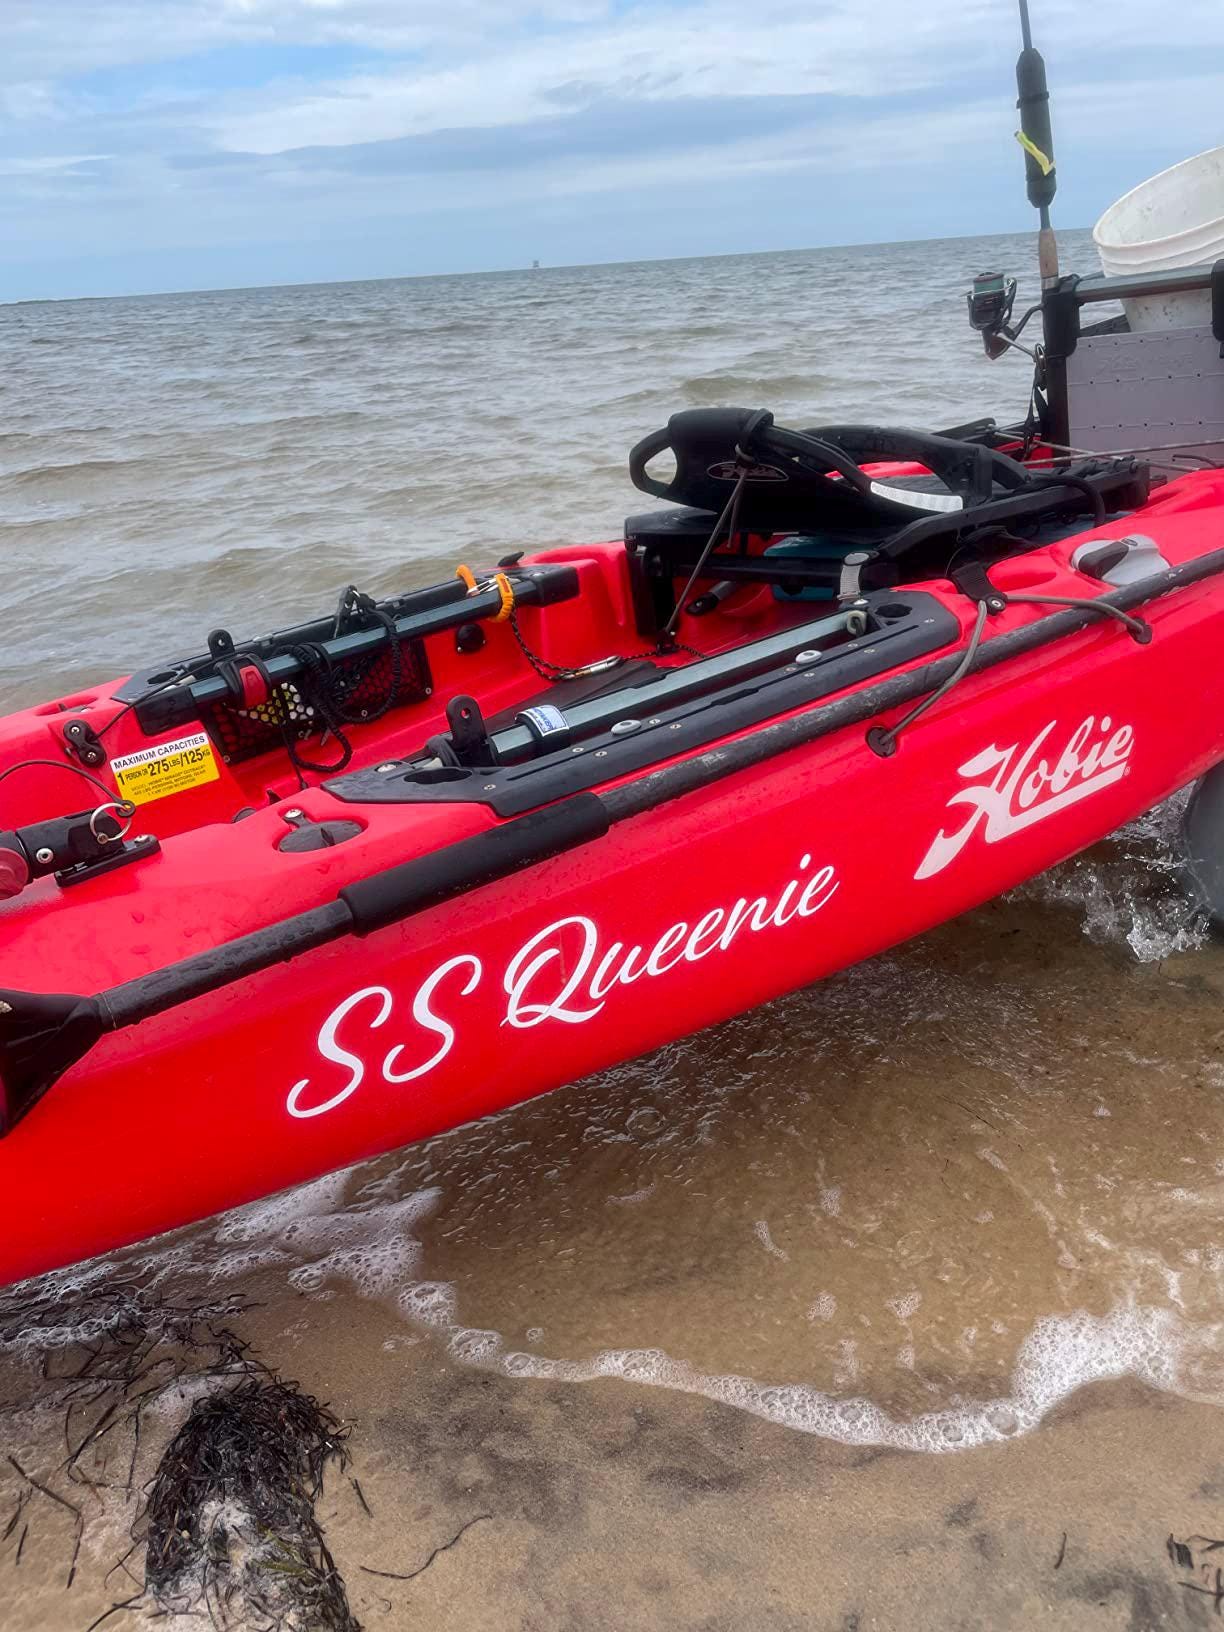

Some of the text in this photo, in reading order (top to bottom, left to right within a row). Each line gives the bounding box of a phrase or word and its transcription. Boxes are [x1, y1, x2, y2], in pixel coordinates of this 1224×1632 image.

[113, 735, 205, 770] MAXIMUM CAPACITIES
[117, 771, 125, 786] 1
[914, 715, 1134, 880] Hobie
[286, 853, 840, 1119] SS Queenie
